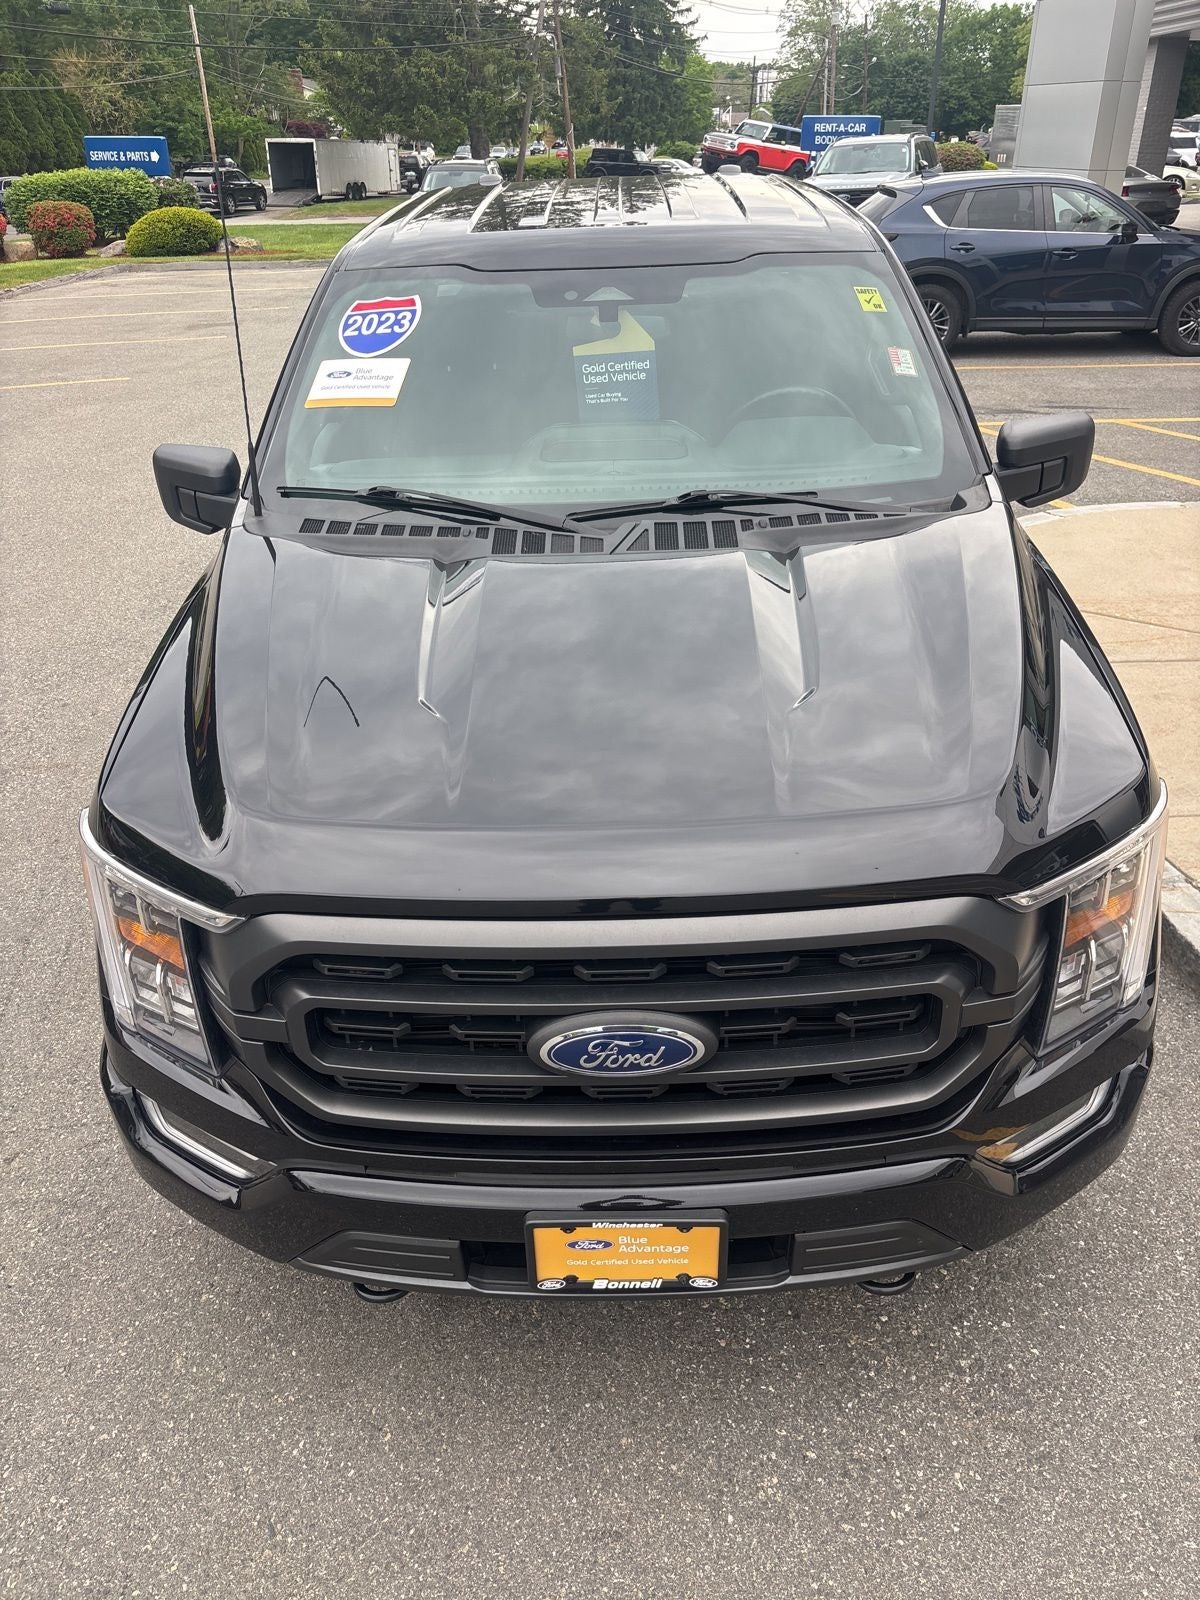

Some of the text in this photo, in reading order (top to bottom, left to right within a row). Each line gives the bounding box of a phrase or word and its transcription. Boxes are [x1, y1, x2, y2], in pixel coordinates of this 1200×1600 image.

[814, 123, 866, 132] RENT-A-CAR
[814, 135, 837, 145] BODY
[89, 150, 150, 162] SERVICE & PARTS
[343, 311, 413, 337] 2023
[582, 360, 650, 373] Gold Certified
[583, 371, 647, 384] Used Vehicle
[580, 1040, 665, 1068] Ford
[575, 1240, 605, 1249] Ford
[618, 1236, 648, 1244] Blue
[618, 1245, 689, 1253] Advantage
[592, 1278, 663, 1289] Bonnell
